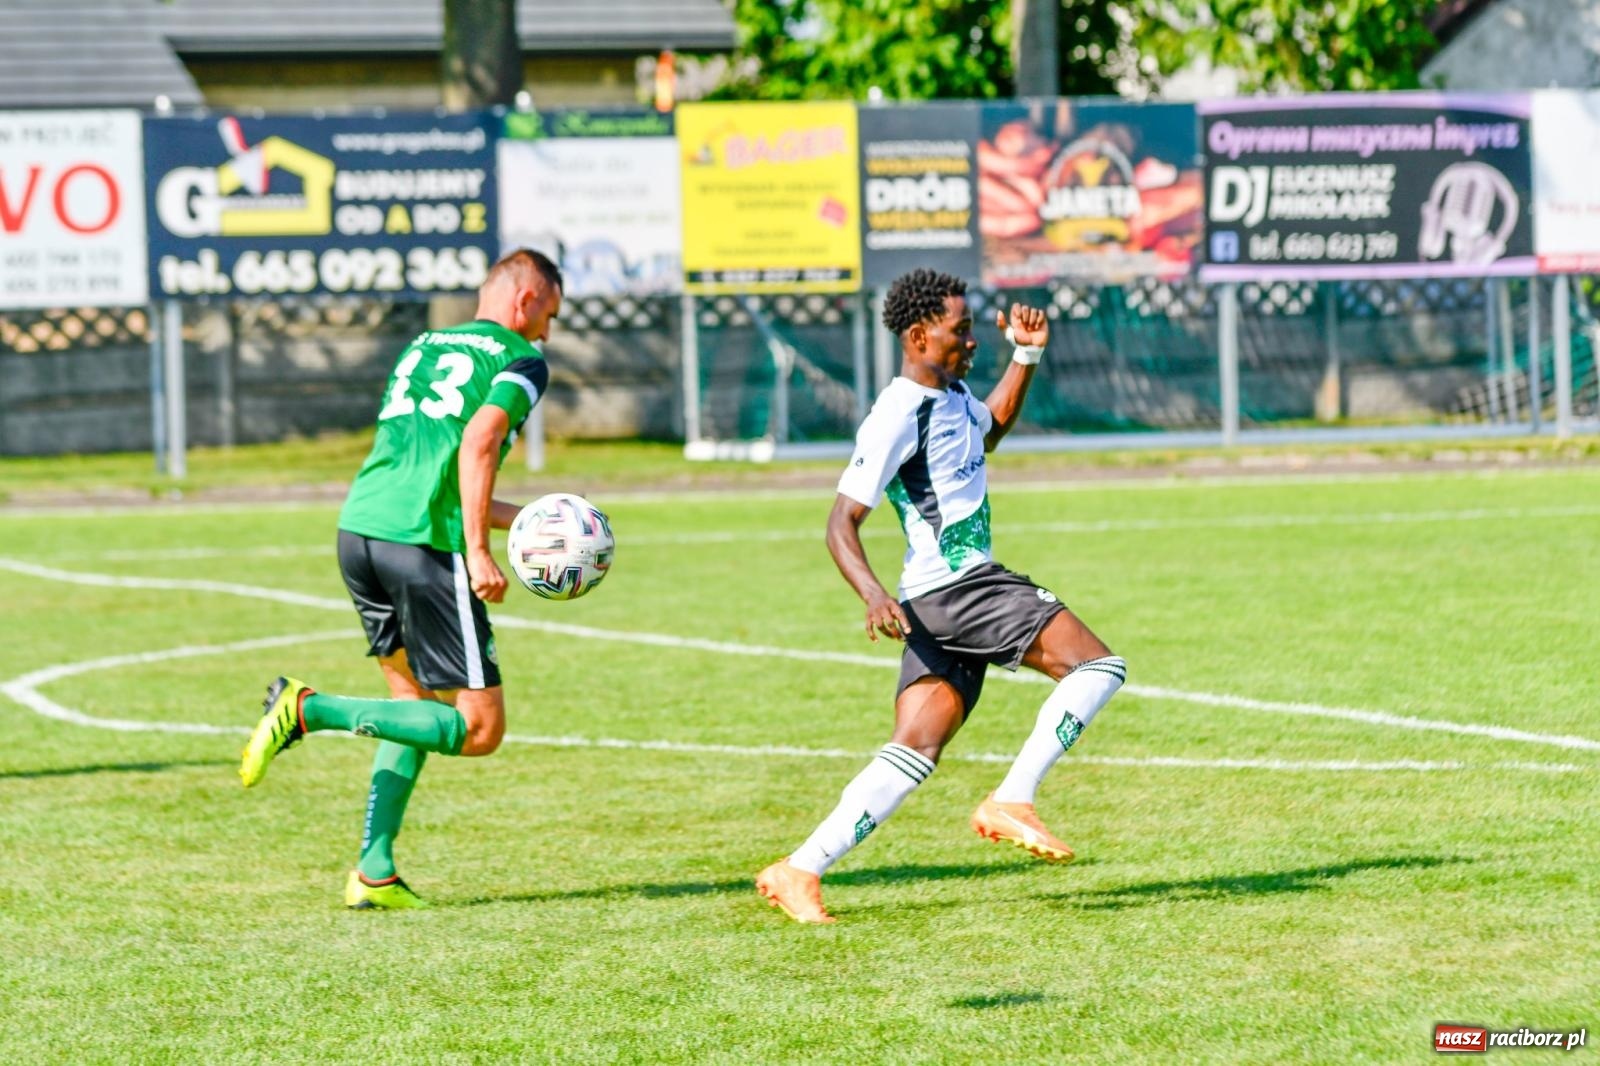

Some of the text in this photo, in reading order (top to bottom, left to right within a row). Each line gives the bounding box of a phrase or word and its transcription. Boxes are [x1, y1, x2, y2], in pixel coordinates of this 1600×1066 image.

[726, 127, 846, 169] BAGER
[1209, 116, 1519, 159] Oprawa muzyczna imprez
[335, 168, 486, 200] BUDUJEMY
[865, 172, 971, 212] DRÓB
[1210, 165, 1270, 227] DJ
[1271, 163, 1395, 193] EUGENIUSZ
[335, 202, 487, 235] OD A DO Z
[1269, 191, 1391, 220] MIKOŁAJEK
[1249, 230, 1281, 260] tel.
[159, 246, 488, 294] tel. 665 092 363
[378, 349, 474, 420] 13
